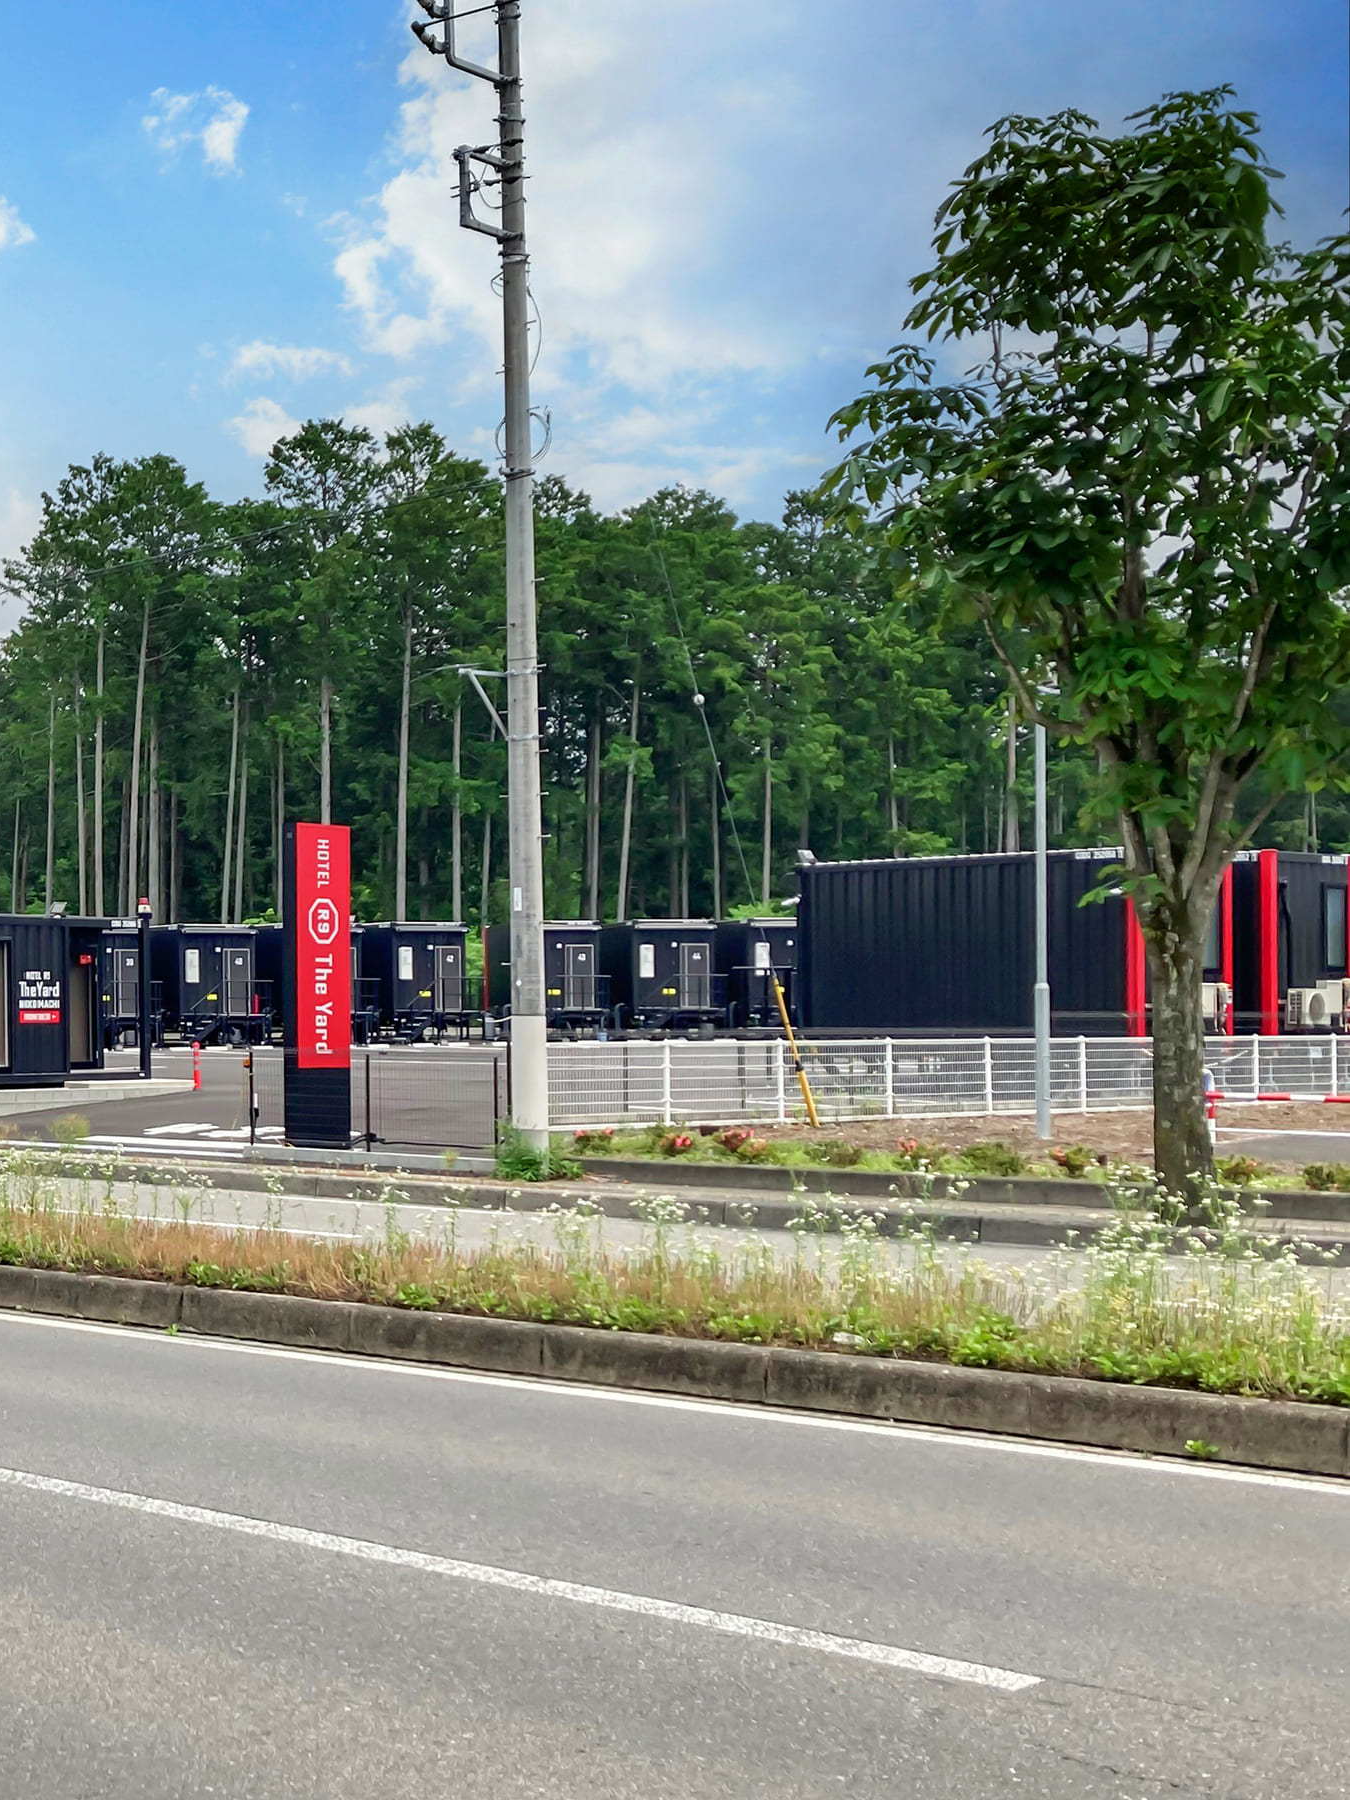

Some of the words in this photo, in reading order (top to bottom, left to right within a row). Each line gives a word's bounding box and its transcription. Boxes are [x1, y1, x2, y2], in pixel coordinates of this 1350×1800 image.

[317, 838, 330, 888] HOTEL
[317, 908, 330, 934] R9
[314, 953, 333, 995] The
[314, 1001, 333, 1055] Yard
